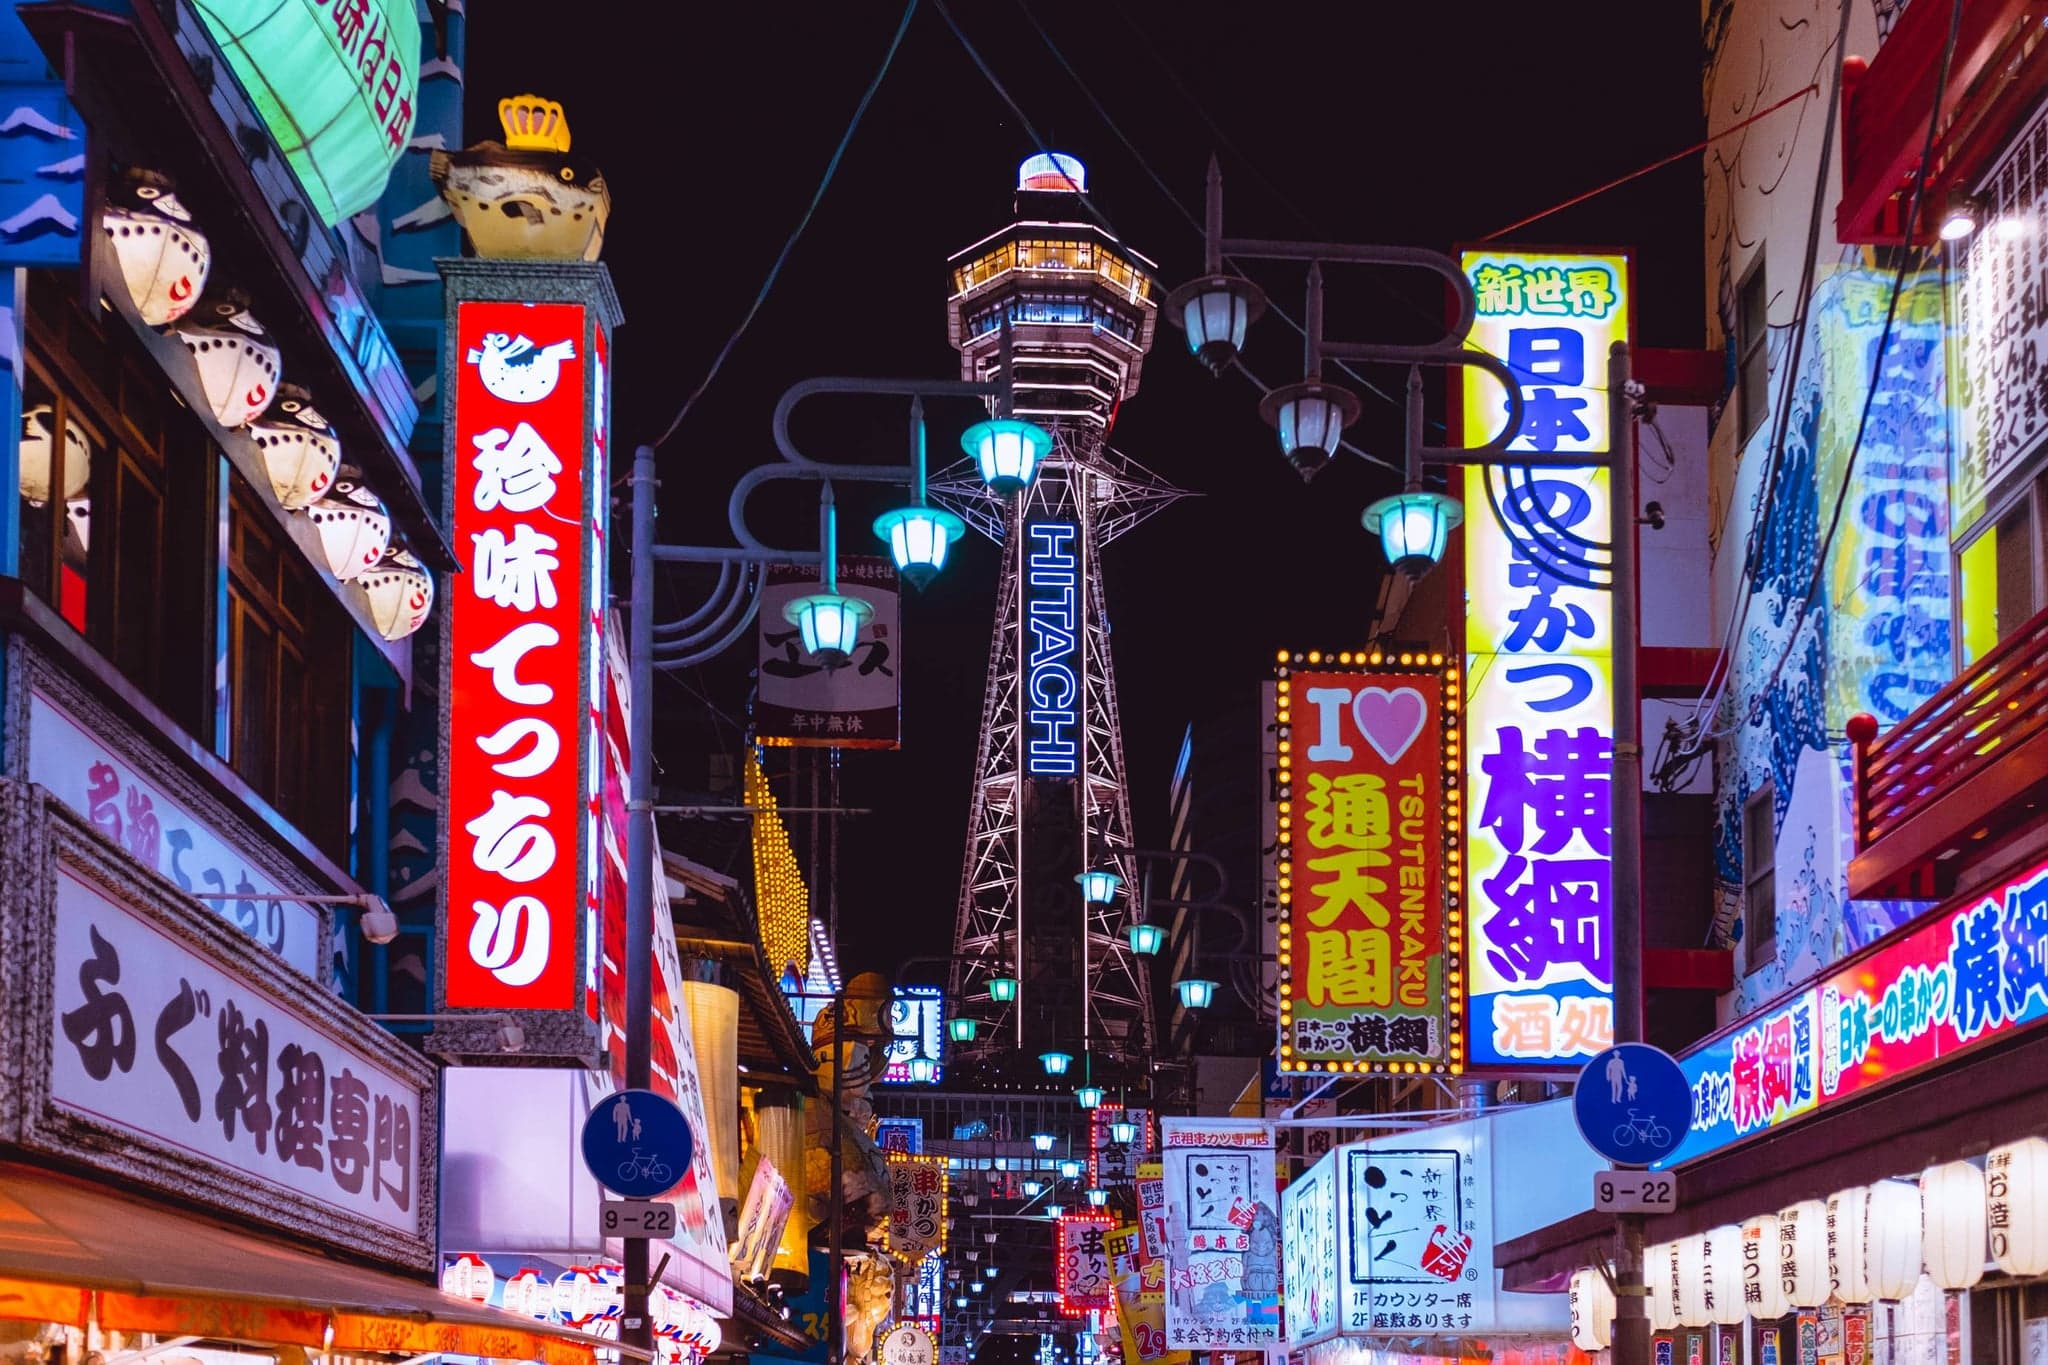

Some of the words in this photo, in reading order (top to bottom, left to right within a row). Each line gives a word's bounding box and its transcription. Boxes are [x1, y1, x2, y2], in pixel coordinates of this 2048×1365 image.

[1476, 263, 1614, 317] 新世界
[1030, 525, 1075, 772] HITACHI
[792, 714, 864, 732] 年中無休
[1307, 687, 1353, 762] I
[1480, 726, 1613, 984] 横綱
[1304, 773, 1392, 1008] 通天閣
[1399, 773, 1427, 1005] TSUTENKAKU
[1297, 1020, 1346, 1033] 日本一の
[1298, 1036, 1346, 1051] 串かつ
[1347, 1014, 1429, 1056] 横綱
[1500, 1001, 1614, 1053] 酒処
[1839, 968, 1949, 1064] 日本一の串かつ
[62, 924, 410, 1212] ふぐ料理専門
[1734, 1014, 1791, 1130] 横綱
[1794, 1004, 1811, 1105] 酒処
[1168, 1131, 1270, 1146] 元祖串カツ専門店
[910, 1167, 940, 1236] 串かつ
[1421, 1168, 1446, 1221] 新世界
[1988, 1173, 2010, 1258] お造り
[1353, 1293, 1368, 1306] 1F
[1374, 1292, 1472, 1308] カウンター席
[1743, 1242, 1762, 1303] もつ鍋
[1172, 1327, 1274, 1344] 宴会予約受付中
[1352, 1313, 1368, 1326] 2F
[1374, 1312, 1472, 1328] 座敷あります
